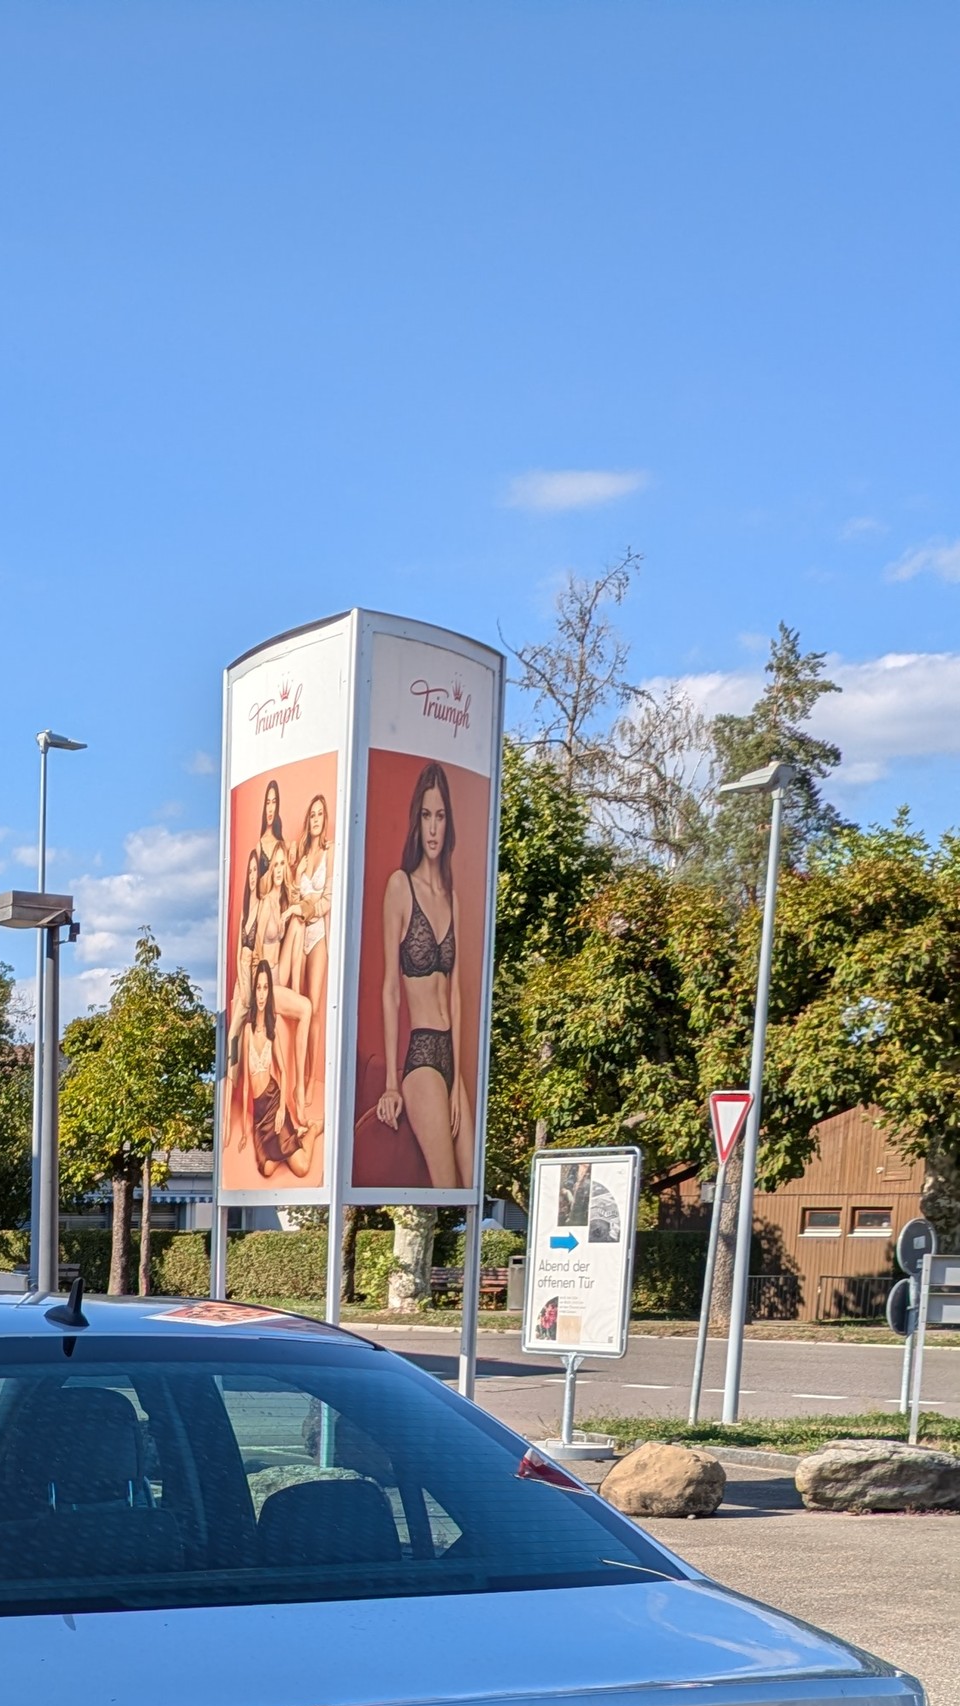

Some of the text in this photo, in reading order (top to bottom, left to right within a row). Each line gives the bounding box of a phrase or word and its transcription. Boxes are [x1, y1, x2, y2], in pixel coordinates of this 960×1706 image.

[248, 683, 303, 738] Triumph
[410, 680, 472, 738] Triumph
[538, 1275, 595, 1289] offenen Tür
[539, 1259, 591, 1273] Abend der
